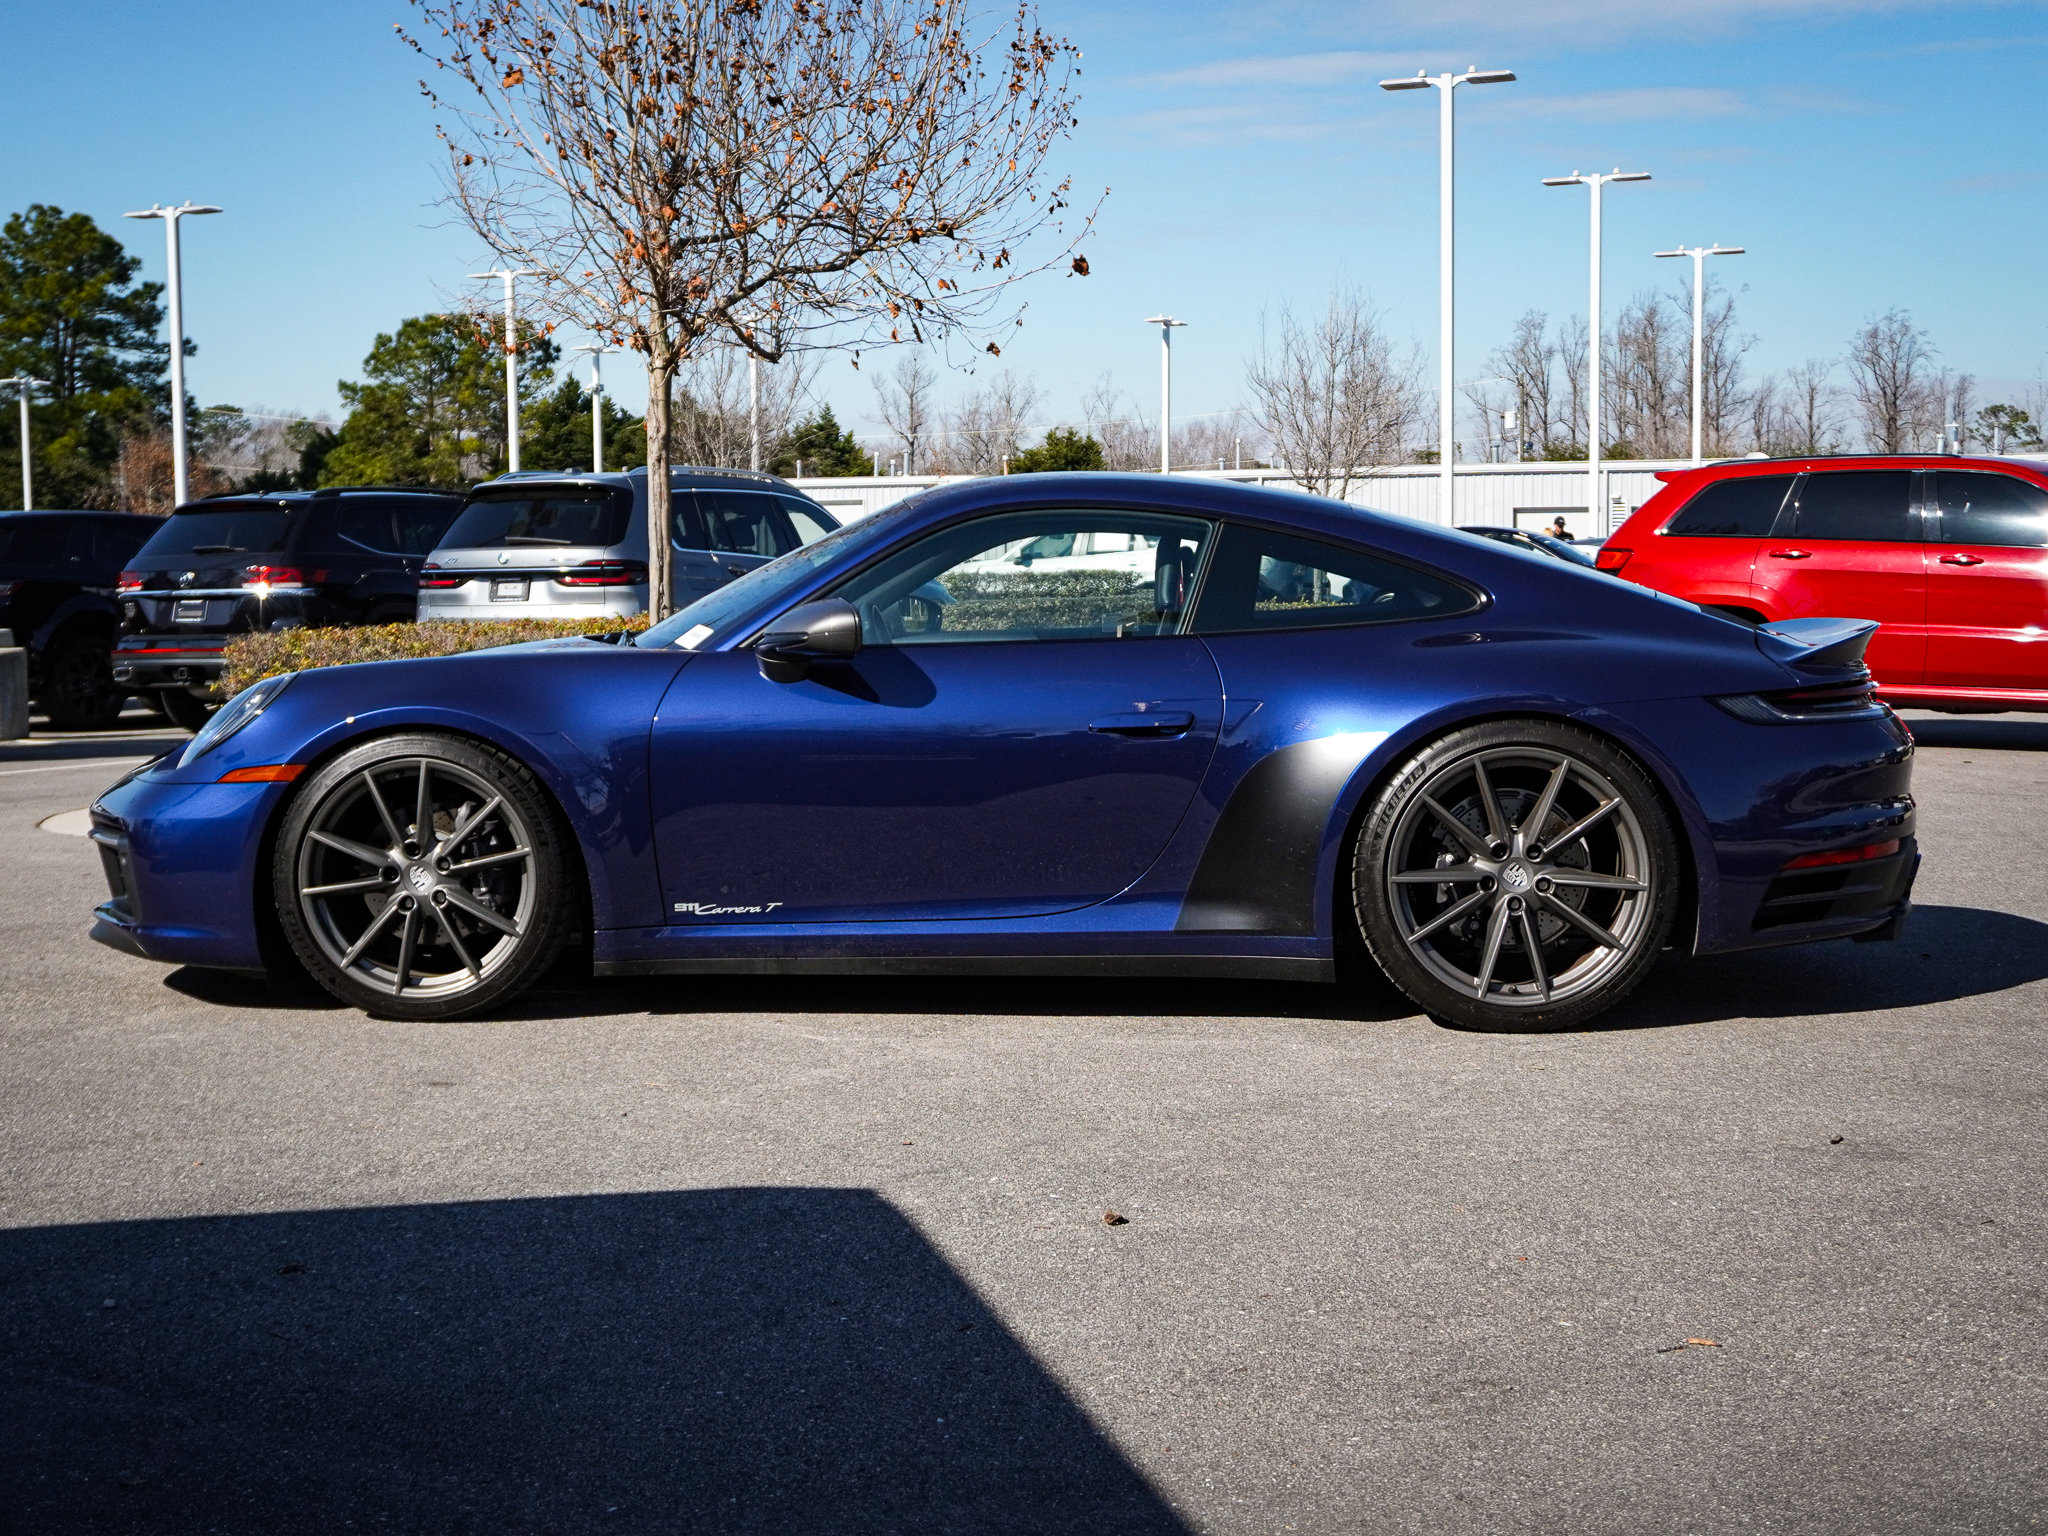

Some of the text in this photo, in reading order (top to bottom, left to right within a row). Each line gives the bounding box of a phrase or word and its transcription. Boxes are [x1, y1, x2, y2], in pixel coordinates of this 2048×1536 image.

[1377, 766, 1425, 836] MICHELIN
[674, 902, 783, 915] 911 Carrera T
